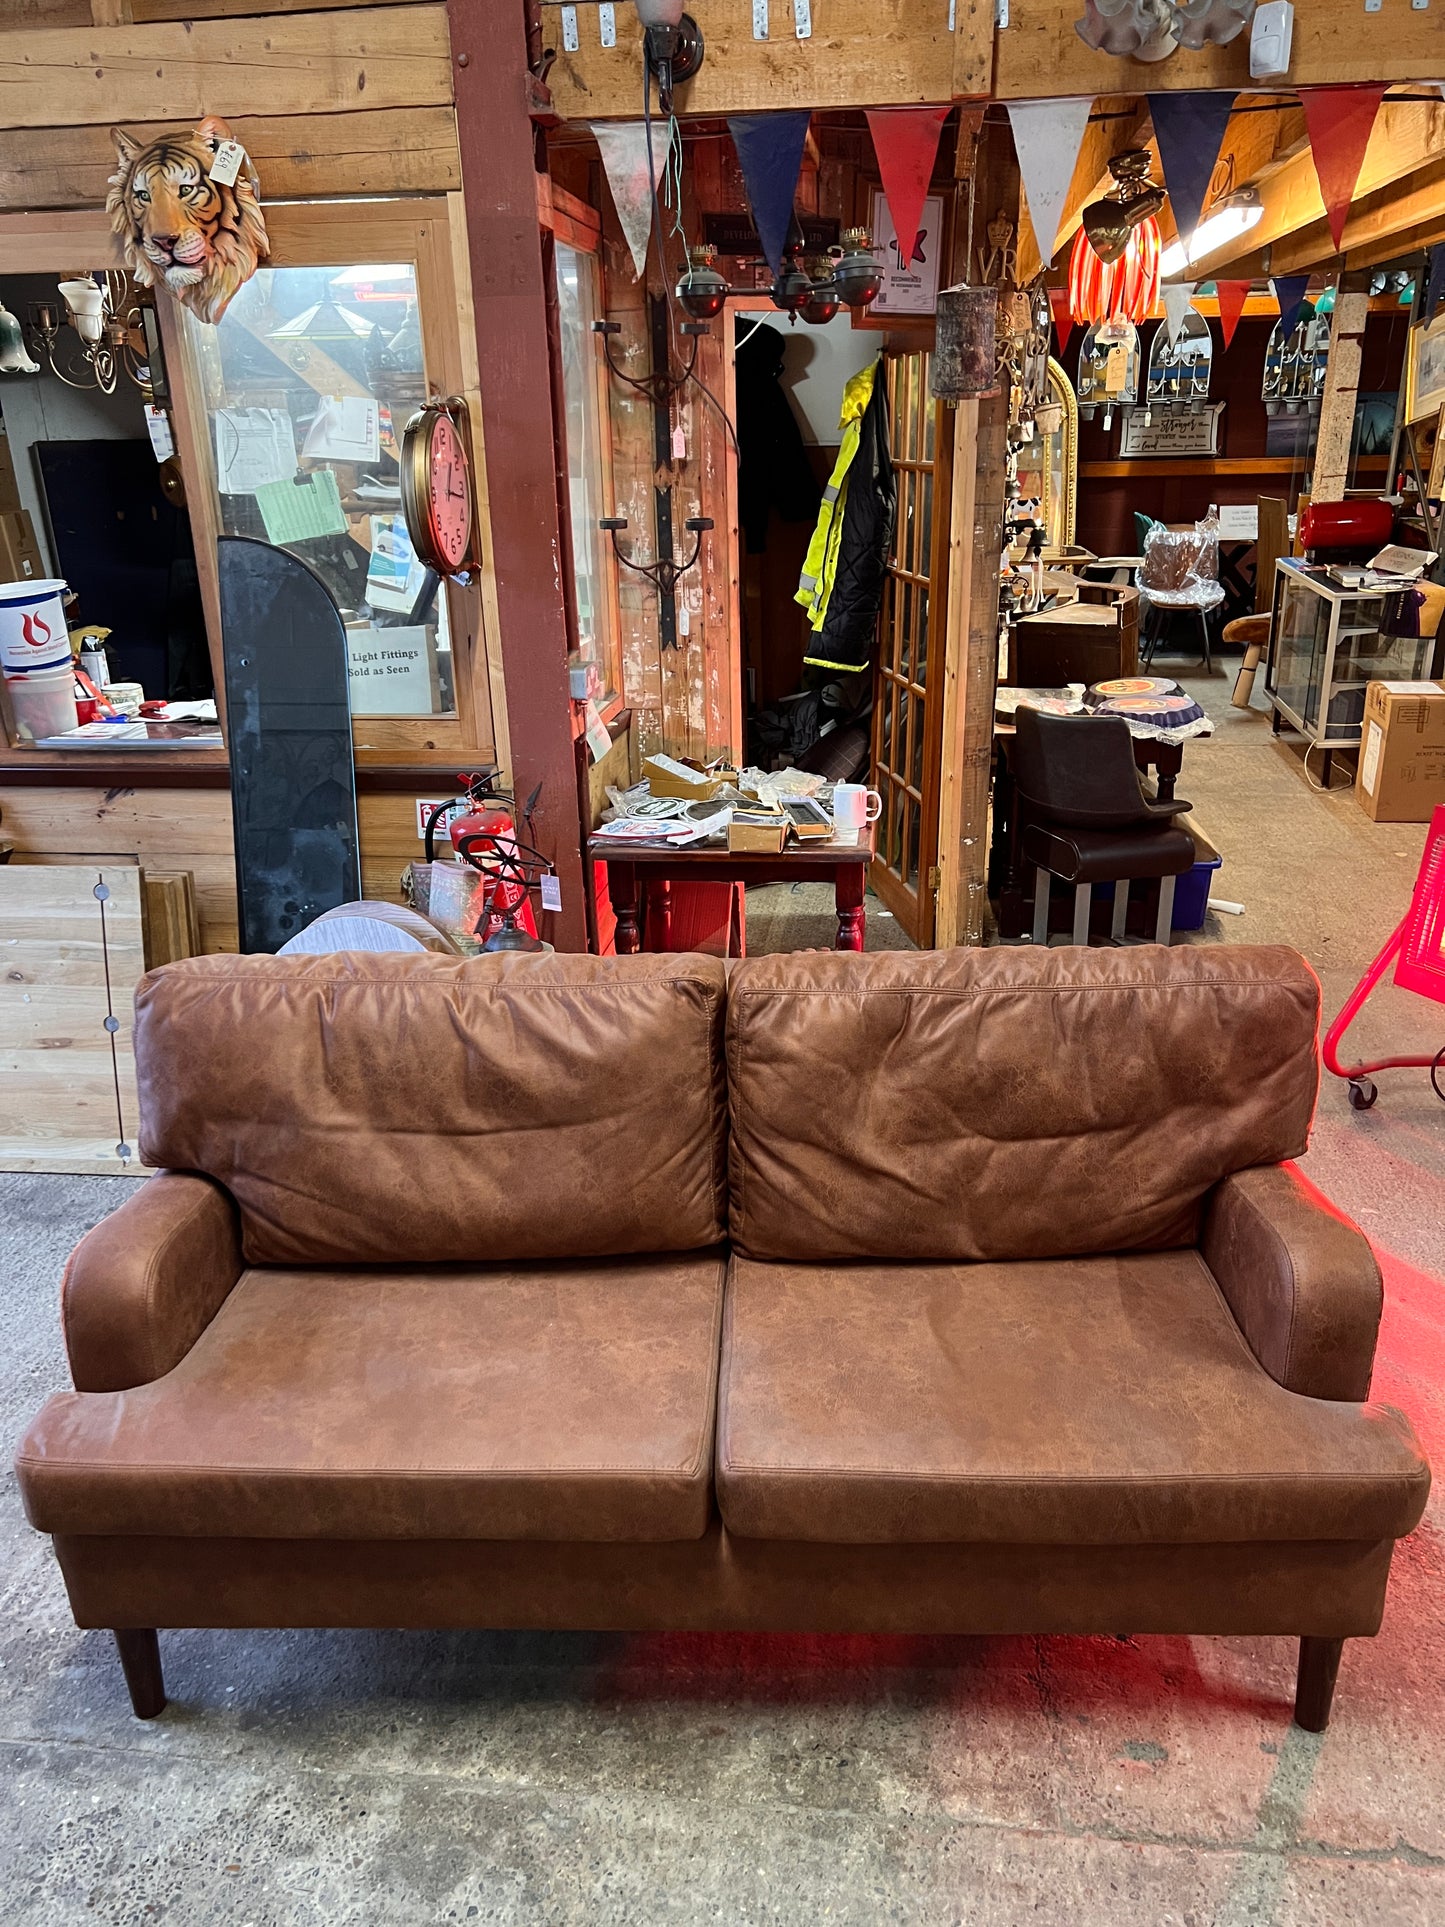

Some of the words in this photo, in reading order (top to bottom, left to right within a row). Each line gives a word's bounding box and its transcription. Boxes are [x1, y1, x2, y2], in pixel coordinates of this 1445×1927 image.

[352, 652, 378, 663] Light
[381, 649, 419, 660] Fittings
[348, 667, 370, 677] Sold
[386, 665, 410, 675] Seen
